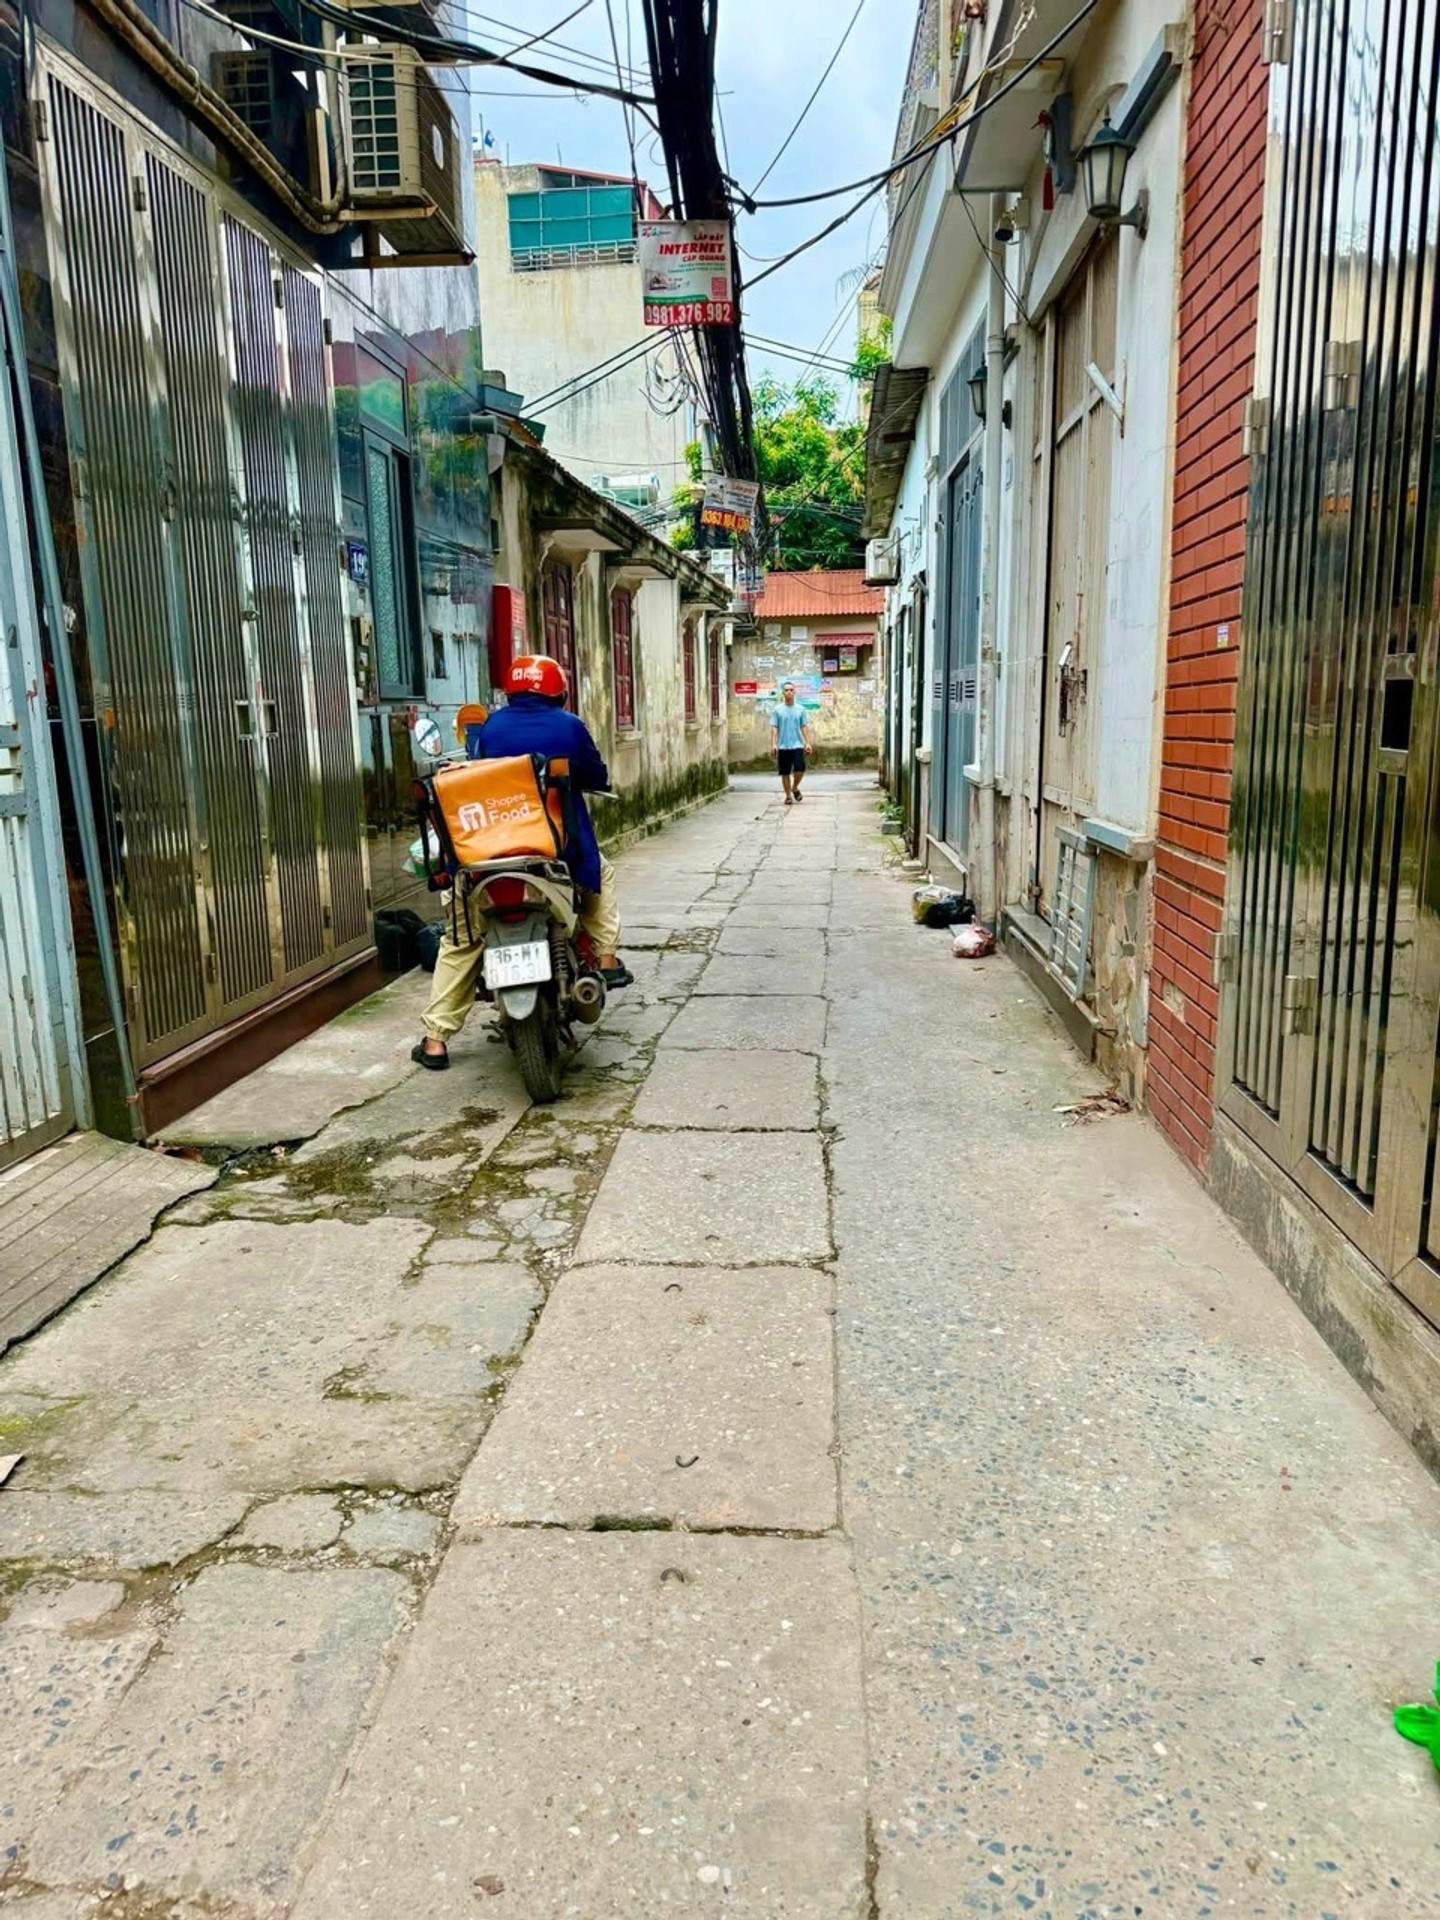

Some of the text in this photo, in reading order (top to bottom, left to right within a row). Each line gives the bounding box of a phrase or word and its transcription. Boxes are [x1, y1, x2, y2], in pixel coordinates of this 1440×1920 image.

[659, 243, 724, 254] INTERNET
[484, 792, 527, 811] Shopee
[488, 801, 532, 825] Food
